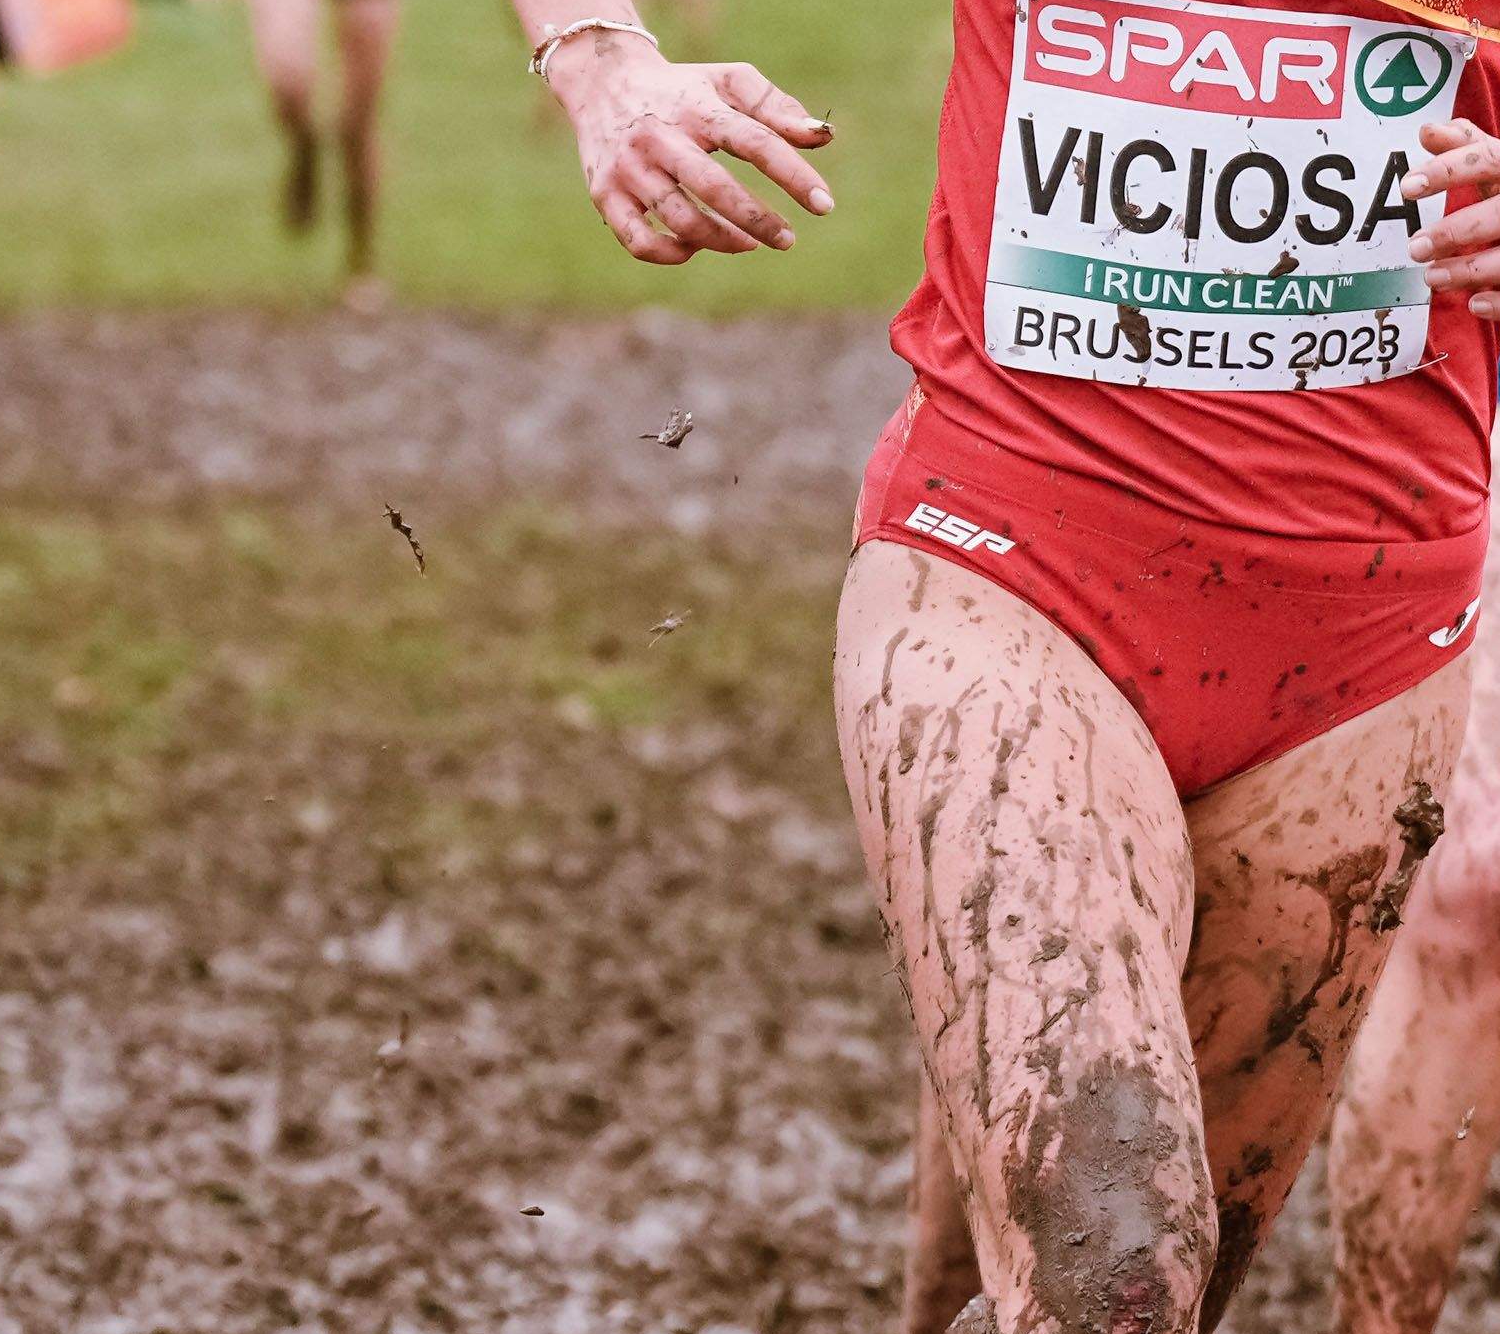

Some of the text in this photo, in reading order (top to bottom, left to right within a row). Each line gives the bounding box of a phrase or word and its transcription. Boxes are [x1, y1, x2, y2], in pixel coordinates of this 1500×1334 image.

[1035, 4, 1339, 106] SPAR
[1017, 117, 1422, 246] VICIOSA
[1084, 263, 1094, 293] I
[1103, 267, 1192, 307] RUN
[1013, 306, 1400, 370] BRUSELS 2023
[903, 502, 1017, 555] ESP
